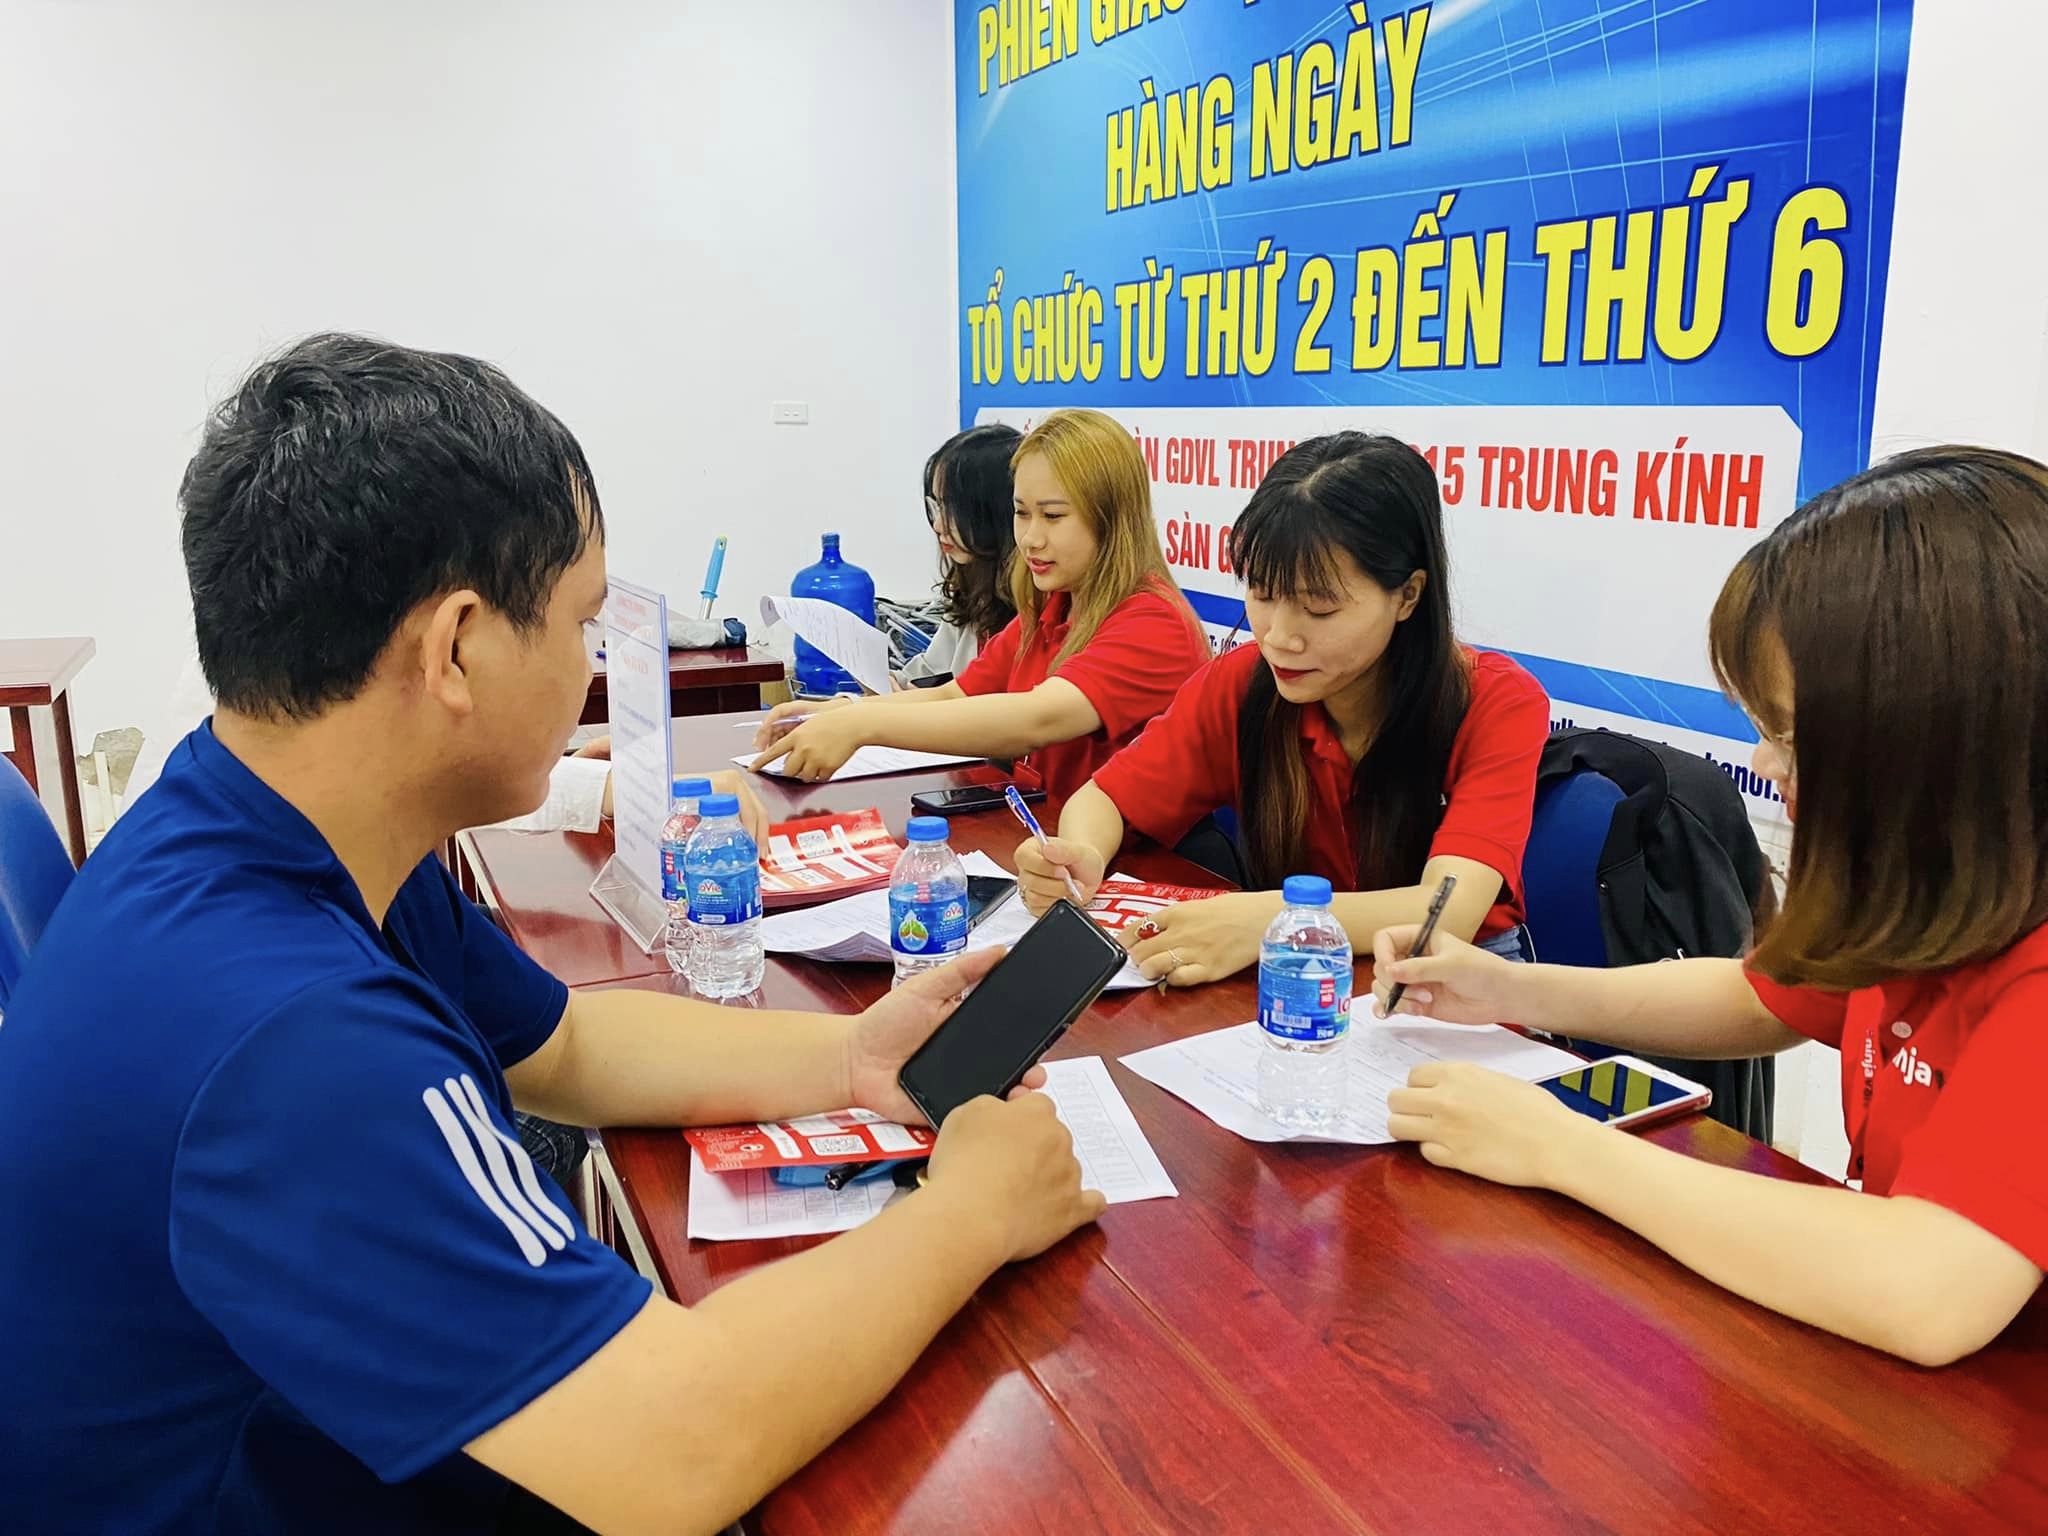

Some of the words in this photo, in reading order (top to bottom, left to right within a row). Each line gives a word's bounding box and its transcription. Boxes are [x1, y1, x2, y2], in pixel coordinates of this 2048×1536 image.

[1106, 77, 1234, 213] HÀNG
[1250, 2, 1431, 179] NGÀY
[967, 268, 1003, 385] TỔ
[1013, 271, 1103, 383] CHỨC
[1114, 257, 1173, 380] TỪ
[1181, 238, 1287, 378] THỨ
[1293, 255, 1336, 374] 2
[1352, 189, 1508, 372] ĐẾN
[1535, 160, 1754, 366] THỨ
[1764, 183, 1852, 361] 6
[1166, 437, 1220, 487] GDVL
[1478, 446, 1618, 516] TRUNG
[1633, 437, 1764, 529] KÍNH
[1166, 511, 1210, 570] SÀN
[1861, 1038, 1877, 1078] ninja
[1892, 1046, 1932, 1087] nja
